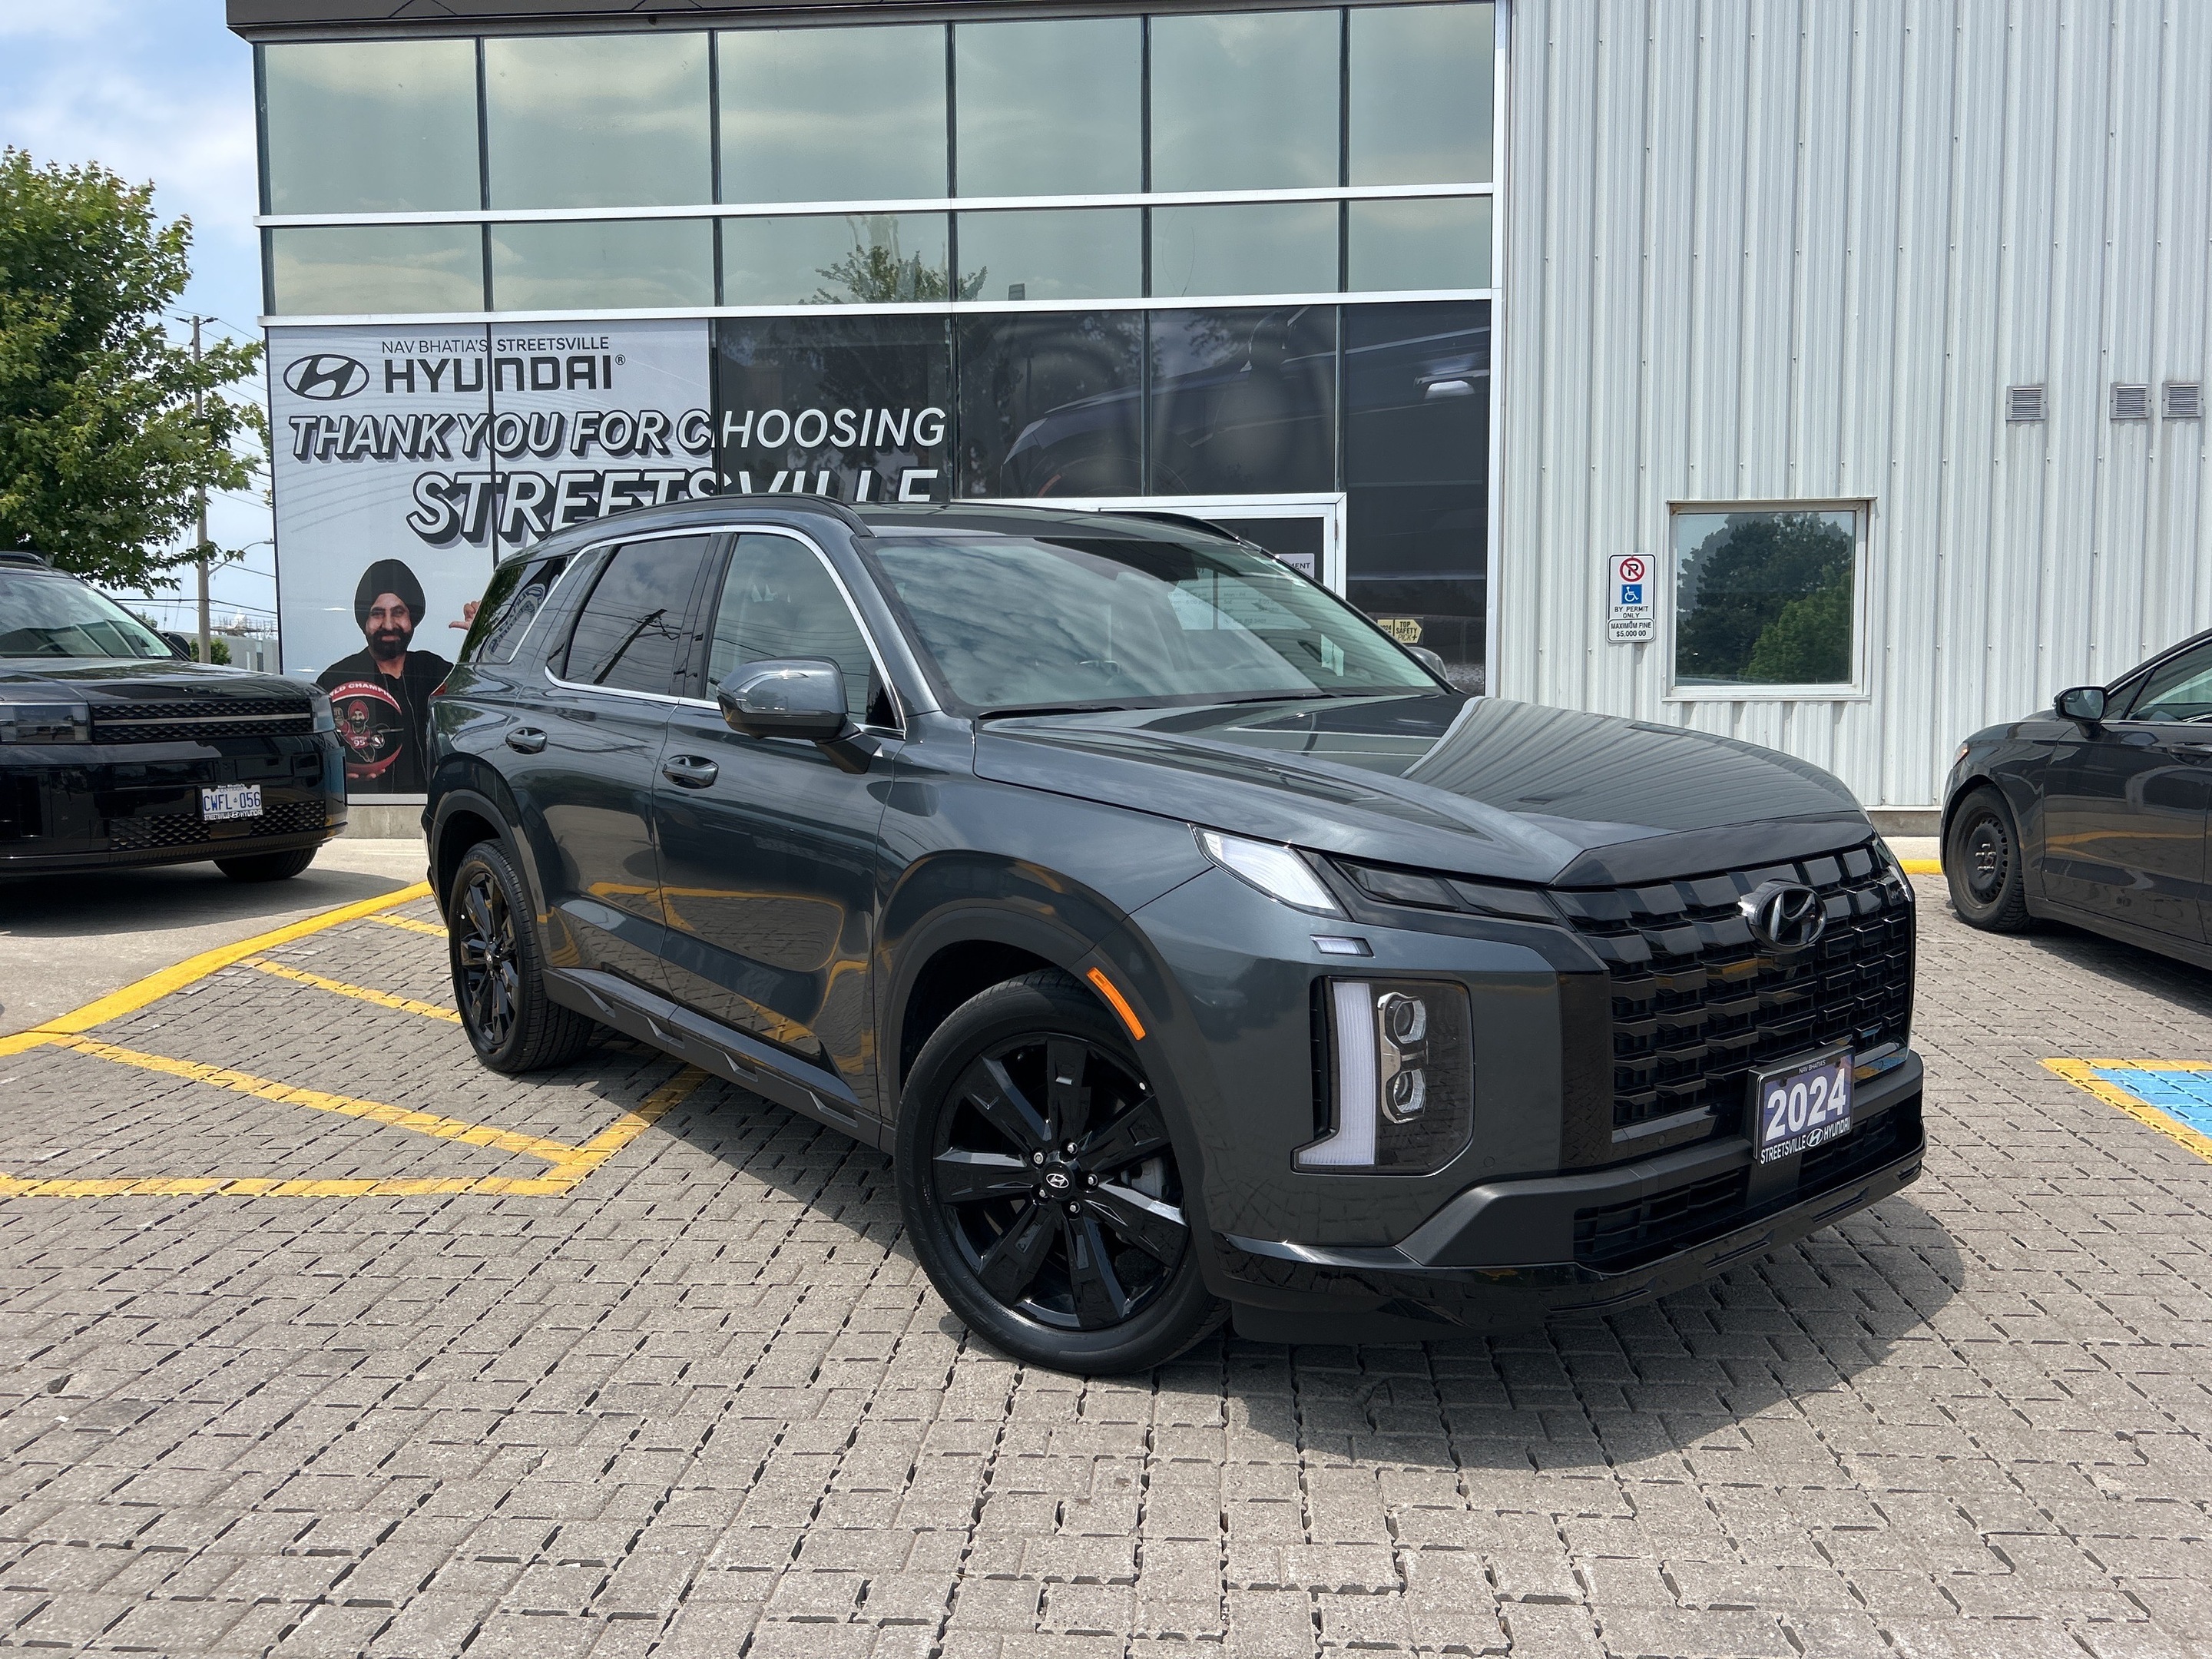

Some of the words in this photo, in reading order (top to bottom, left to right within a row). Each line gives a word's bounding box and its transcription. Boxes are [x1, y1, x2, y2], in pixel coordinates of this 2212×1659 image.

[382, 339, 417, 354] NAV
[419, 339, 488, 353] BHATIA'S
[497, 336, 610, 352] STREETSVILLE
[289, 415, 455, 461] THANK
[459, 412, 560, 460] YOU
[571, 409, 670, 459] FOR
[676, 407, 947, 457] CHOOSING
[204, 793, 233, 812] CWFL
[239, 791, 261, 809] 056
[240, 809, 263, 818] HYUNDAI
[1765, 1068, 1846, 1142] 2024
[1760, 1134, 1806, 1165] STREETSVILLE
[1823, 1116, 1851, 1141] HYUNDAI
